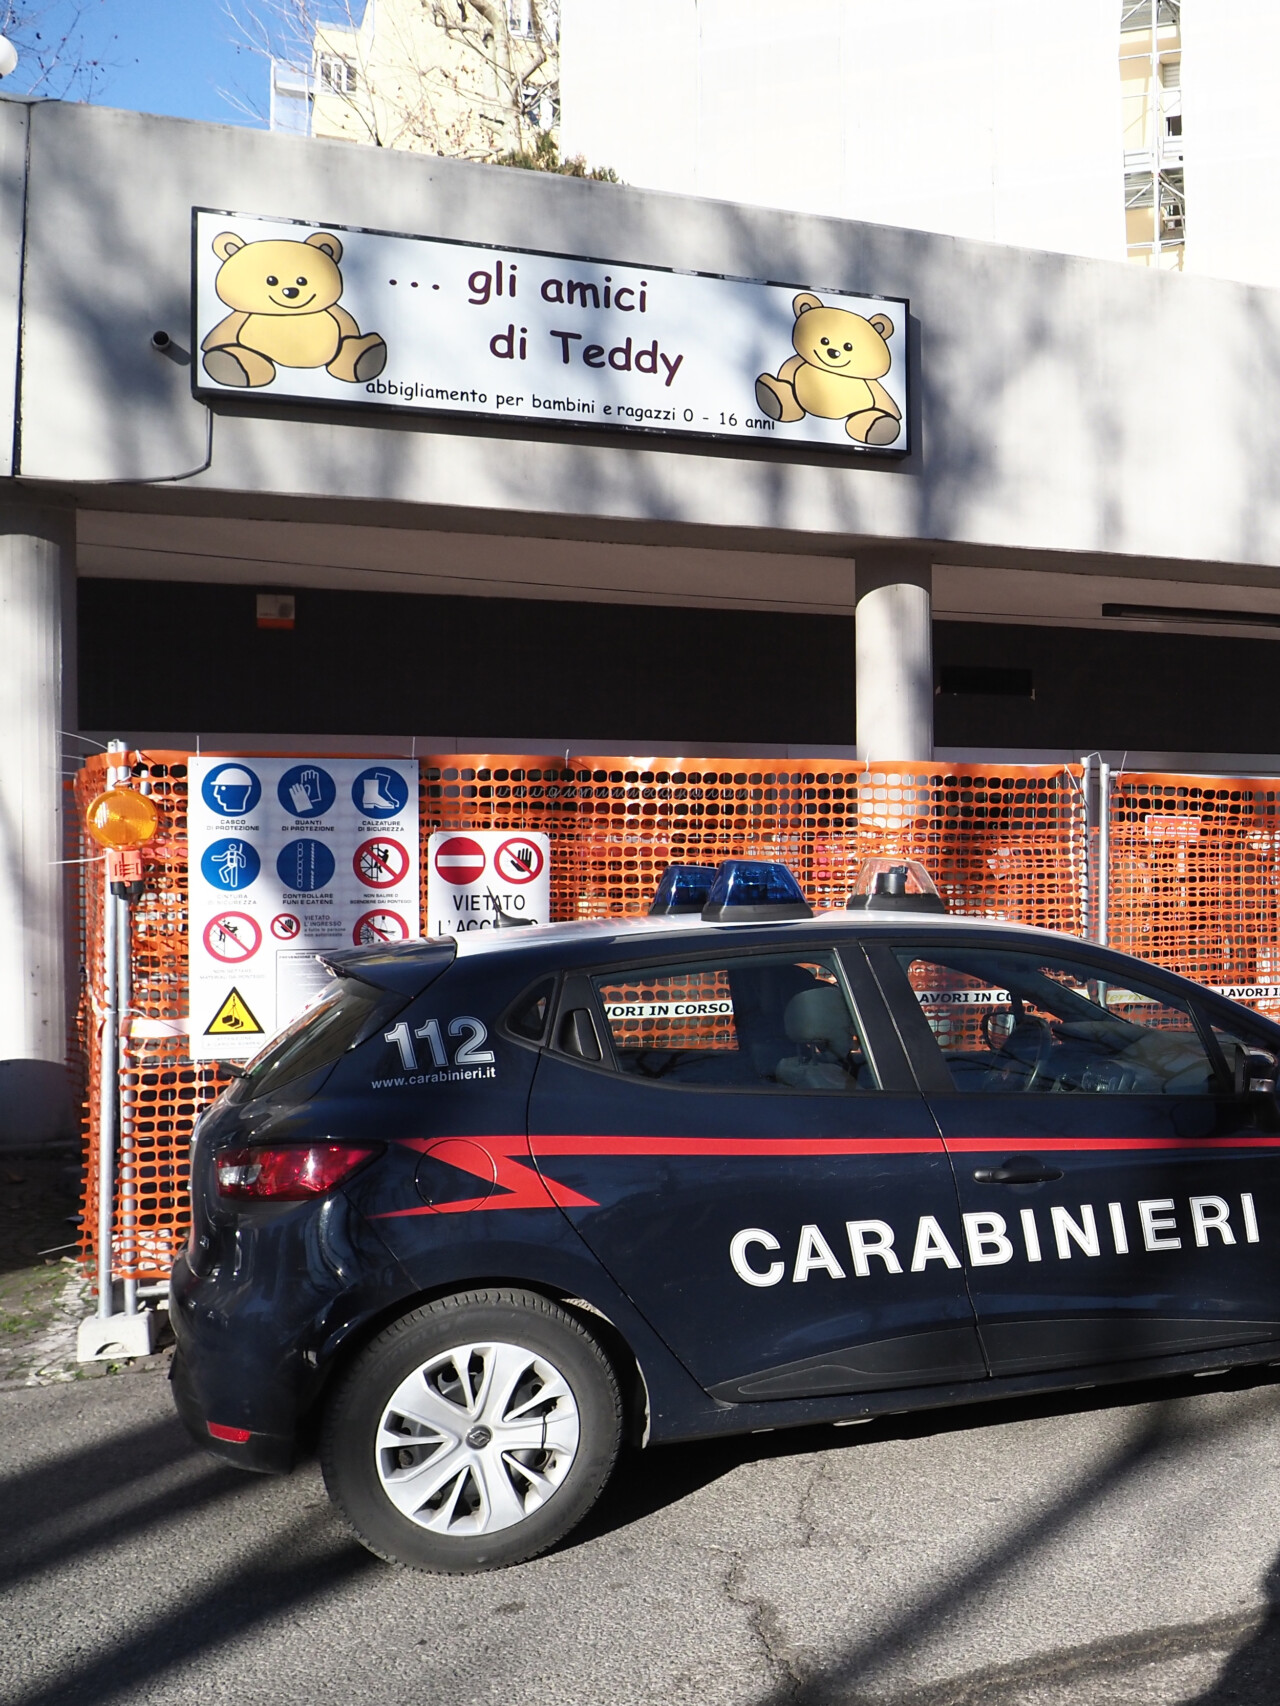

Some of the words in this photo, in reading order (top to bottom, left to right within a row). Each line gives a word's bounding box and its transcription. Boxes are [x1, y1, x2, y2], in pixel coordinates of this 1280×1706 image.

[468, 260, 518, 305] gli
[541, 276, 648, 313] amici
[490, 324, 528, 361] di
[550, 330, 684, 387] Teddy
[366, 379, 487, 403] abbigliamento
[496, 394, 524, 408] per
[532, 394, 595, 414] bambini
[603, 405, 612, 415] e
[617, 405, 675, 421] ragazzi
[720, 412, 737, 426] 16
[745, 418, 775, 430] anni
[453, 894, 526, 911] VIETATO
[605, 1006, 644, 1017] VORI
[649, 1005, 669, 1016] IN
[674, 1003, 729, 1015] CORSO
[919, 992, 969, 1003] AVORI
[974, 992, 991, 1002] IN
[1221, 987, 1270, 997] LAVORI
[384, 1015, 496, 1071] 112
[371, 1067, 497, 1089] www.carabinieri.it
[729, 1192, 1260, 1287] CARABINIERI
